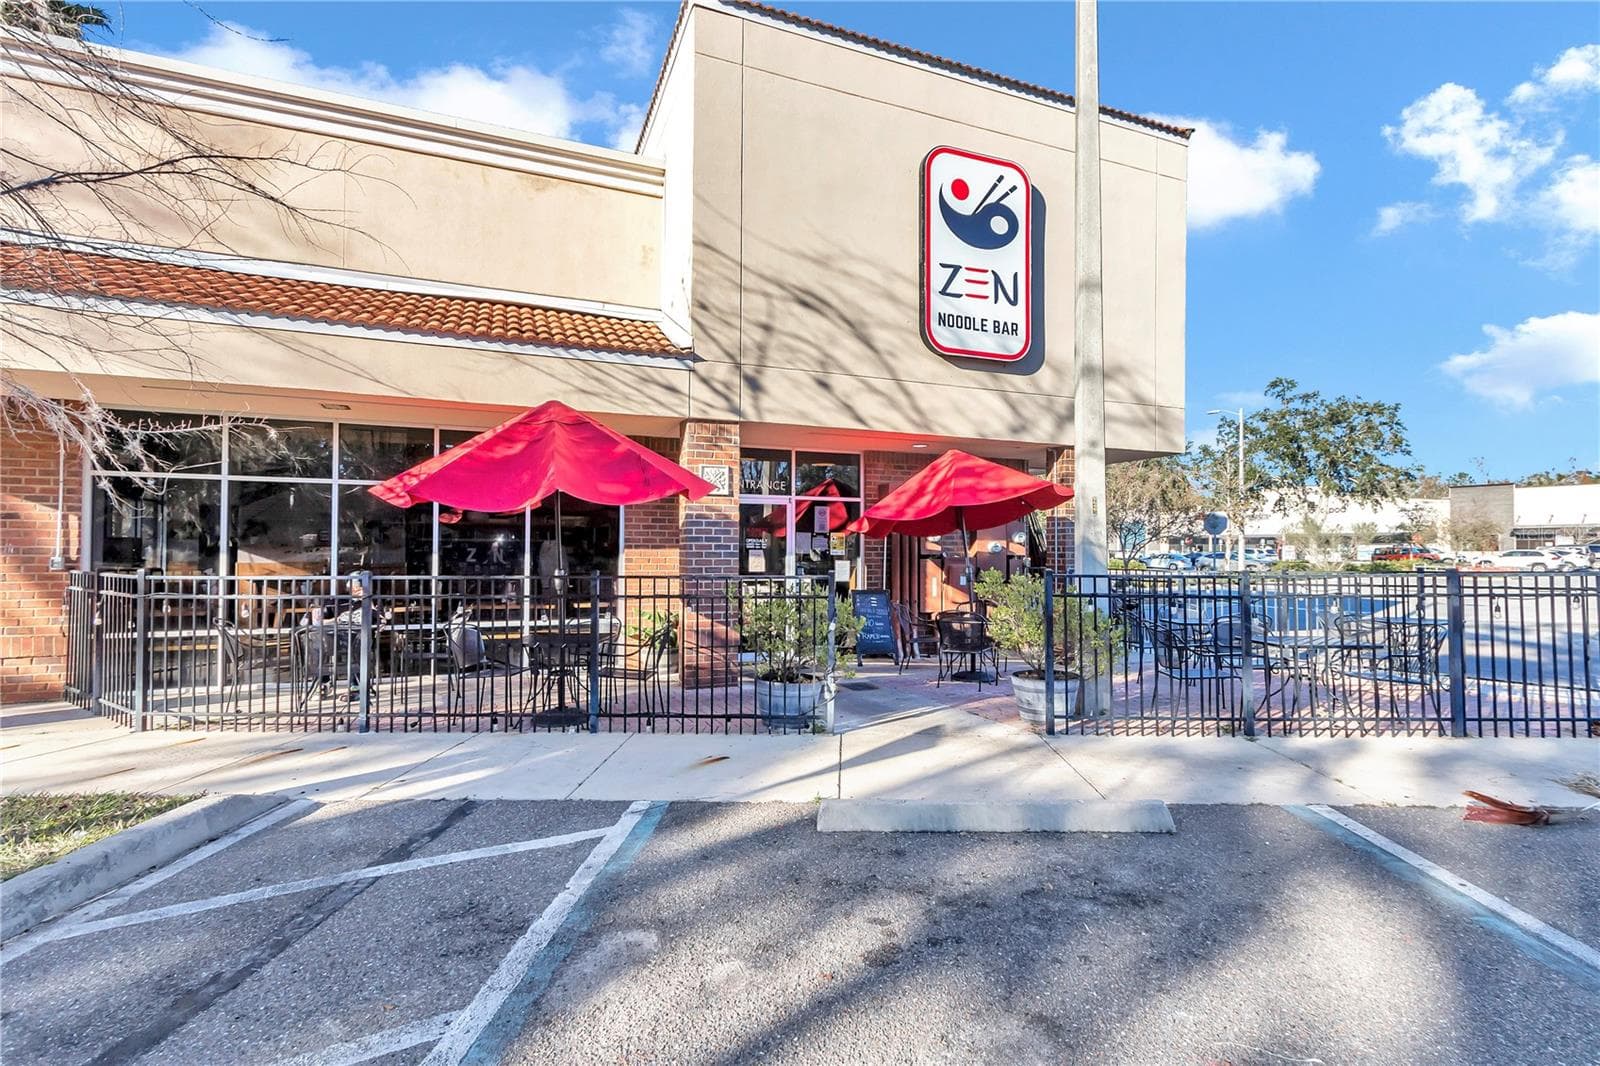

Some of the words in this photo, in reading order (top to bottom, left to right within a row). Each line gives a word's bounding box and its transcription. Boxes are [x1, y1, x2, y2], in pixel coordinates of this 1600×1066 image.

[938, 262, 1019, 307] ZEN
[938, 312, 988, 332] NOODLE
[993, 320, 1019, 336] BAR
[739, 480, 786, 491] NTRANCE
